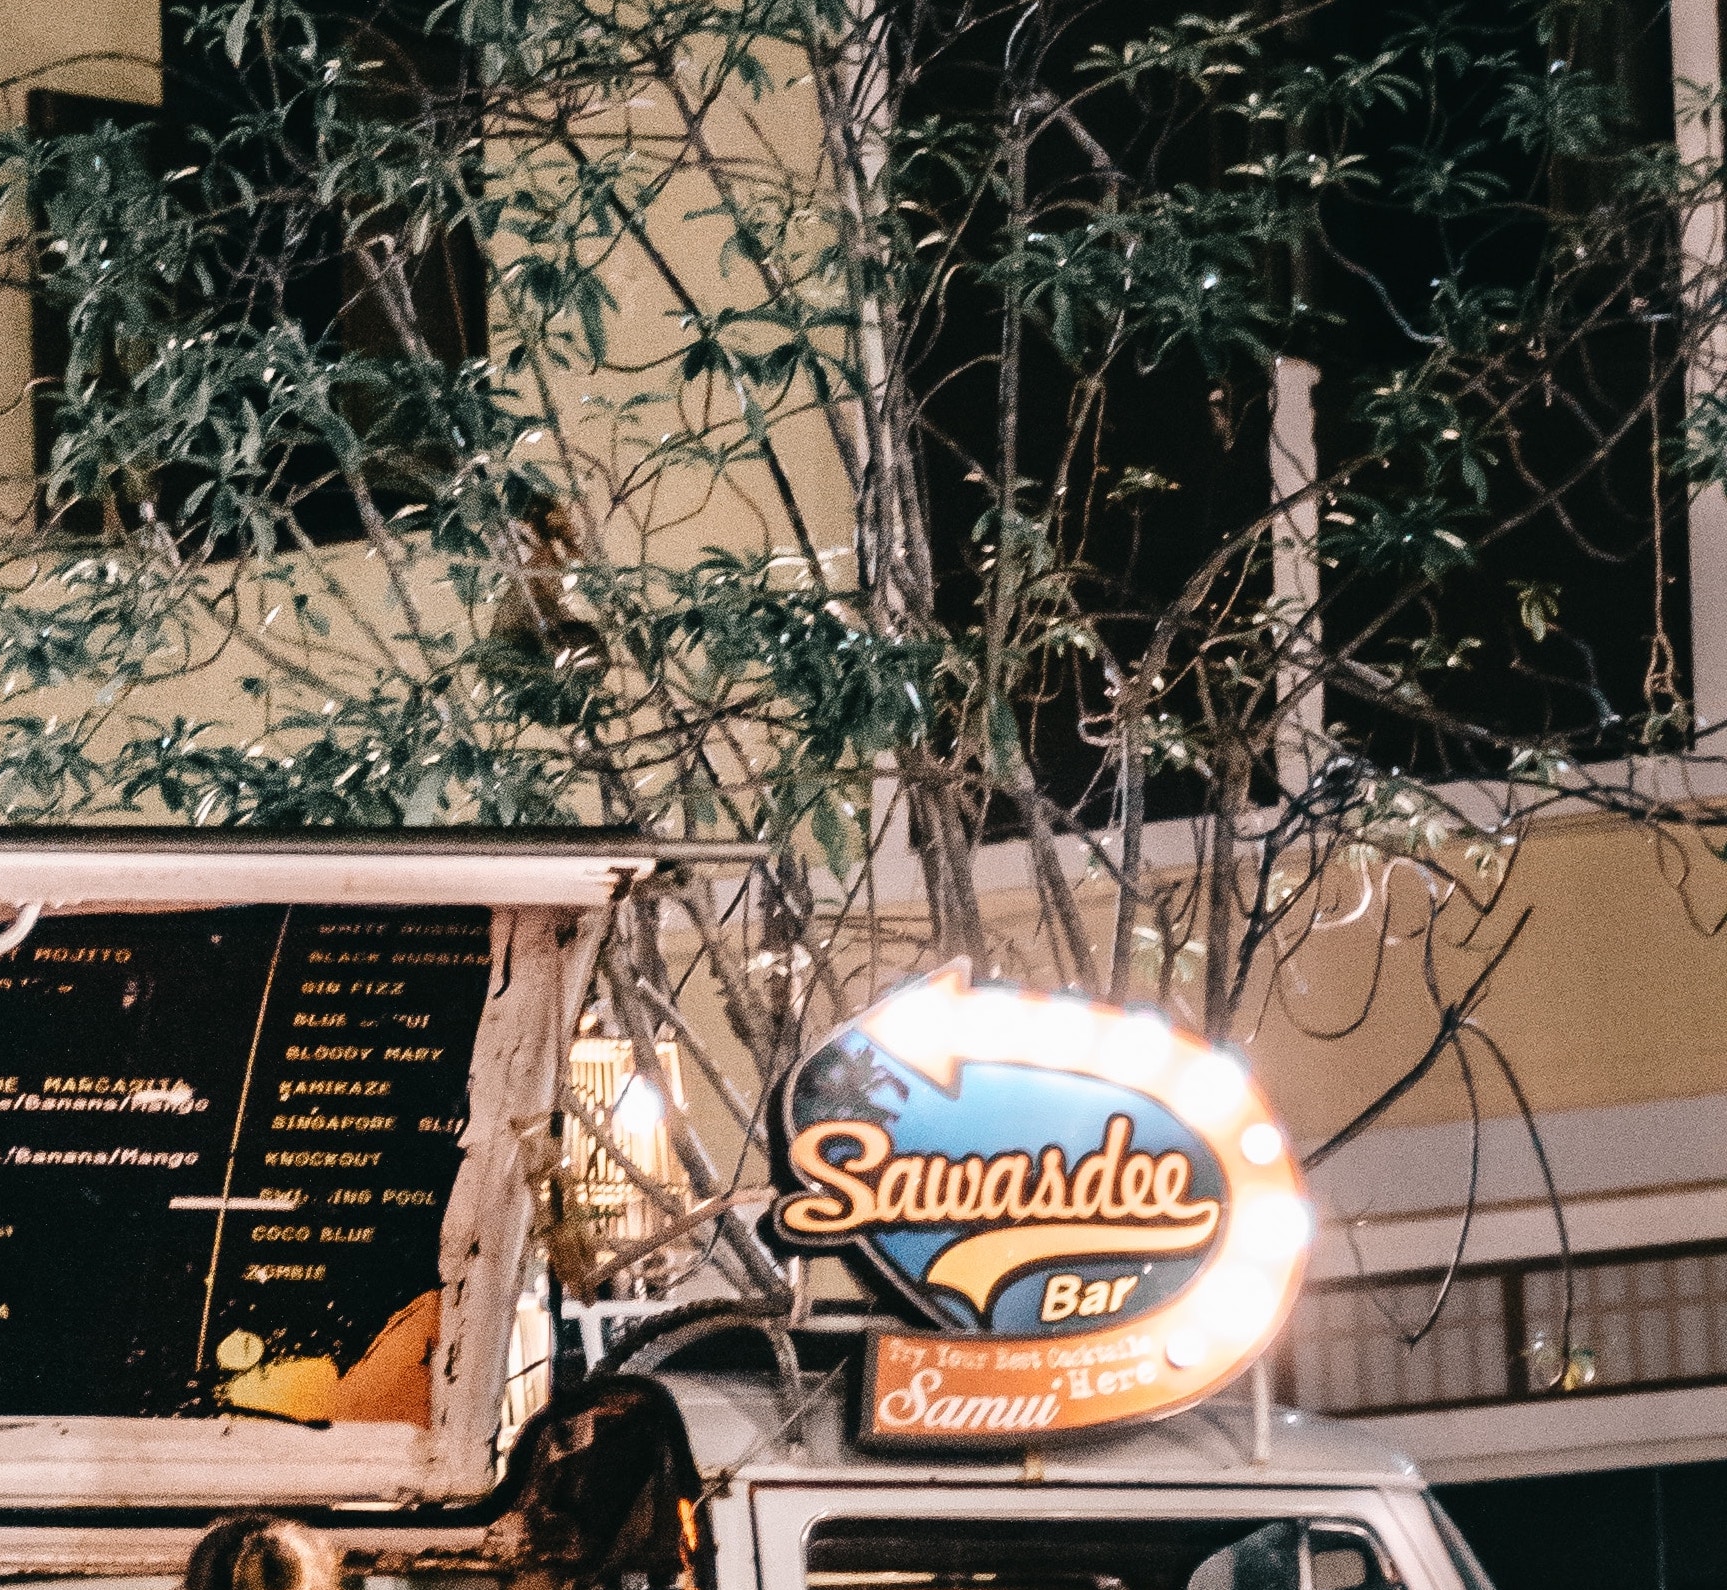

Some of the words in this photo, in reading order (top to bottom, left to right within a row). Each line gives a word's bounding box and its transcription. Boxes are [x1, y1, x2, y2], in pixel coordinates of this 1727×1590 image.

[34, 948, 131, 963] MOJITO
[308, 951, 379, 963] BLACK
[301, 981, 340, 994] GIN
[350, 982, 404, 995] FIZZ
[293, 1013, 345, 1027] BLUE
[286, 1046, 372, 1060] BLOODY
[384, 1048, 443, 1061] MARY
[278, 1080, 391, 1096] KAMIKAZE
[272, 1115, 397, 1131] SINGAPORE
[265, 1151, 381, 1167] KNOCKOUT
[784, 1114, 1218, 1232] Sawasdee
[382, 1189, 434, 1206] POOL
[251, 1225, 310, 1241] COCO
[320, 1227, 374, 1242] BLUE
[242, 1263, 326, 1281] ZOMBIE
[1040, 1273, 1138, 1323] Bar
[936, 1345, 988, 1369] Your
[994, 1347, 1043, 1370] Best
[1067, 1360, 1158, 1400] Here
[878, 1368, 1063, 1430] Samui
